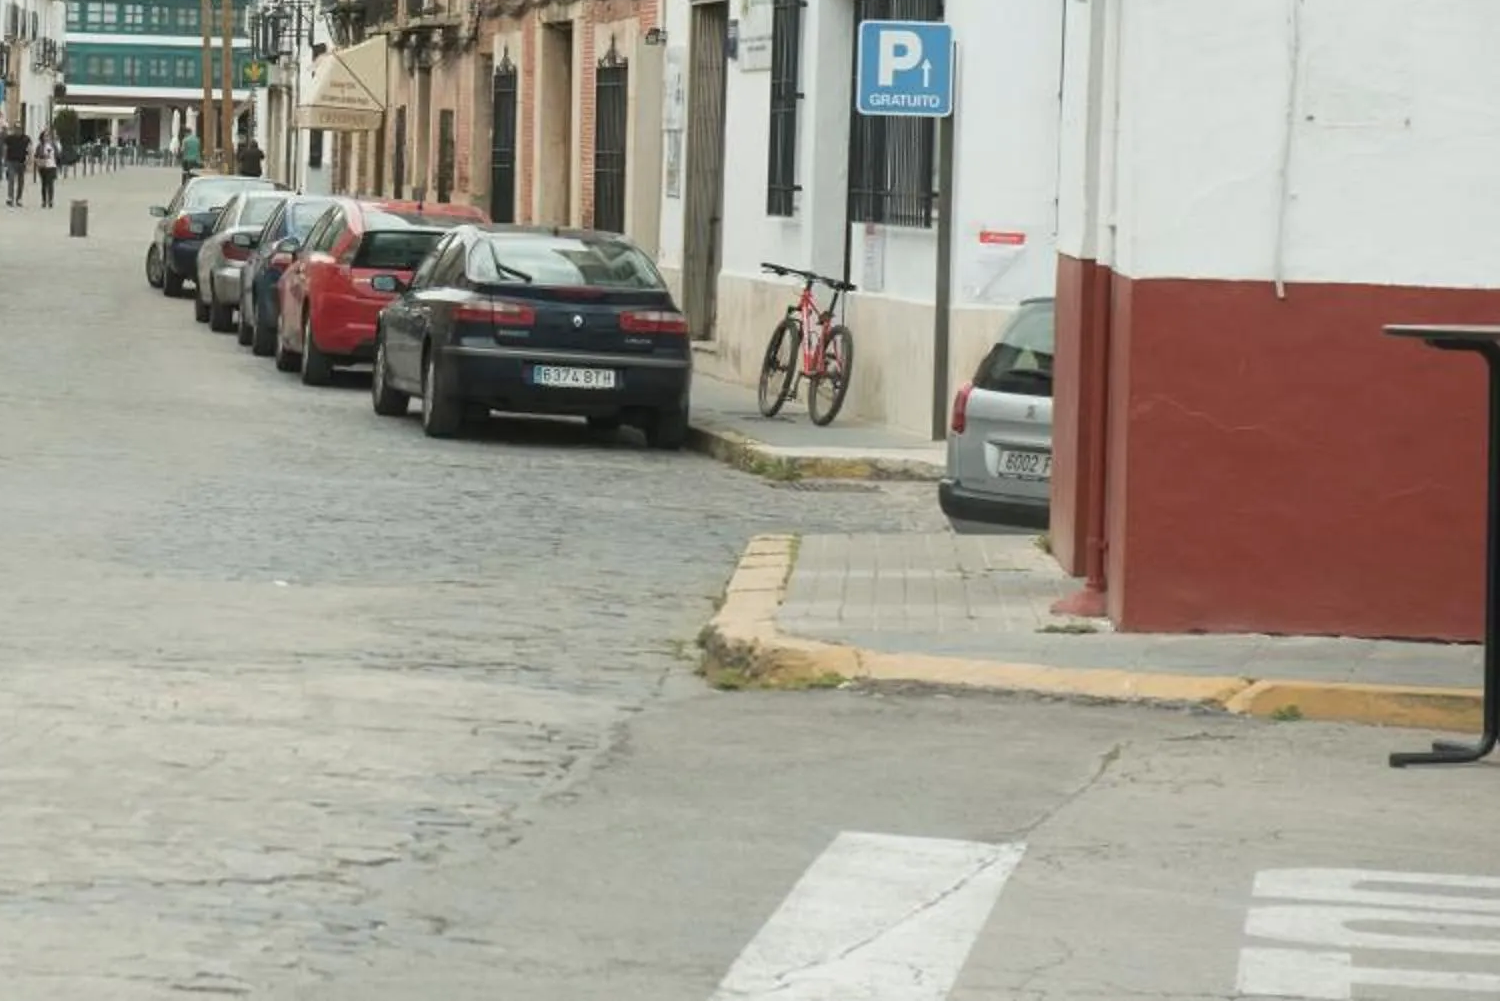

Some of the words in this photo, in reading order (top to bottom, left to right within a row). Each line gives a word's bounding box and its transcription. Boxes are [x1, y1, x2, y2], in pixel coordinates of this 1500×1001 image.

[878, 30, 922, 86] P
[869, 93, 940, 109] GRATUITO
[543, 367, 579, 385] 6374
